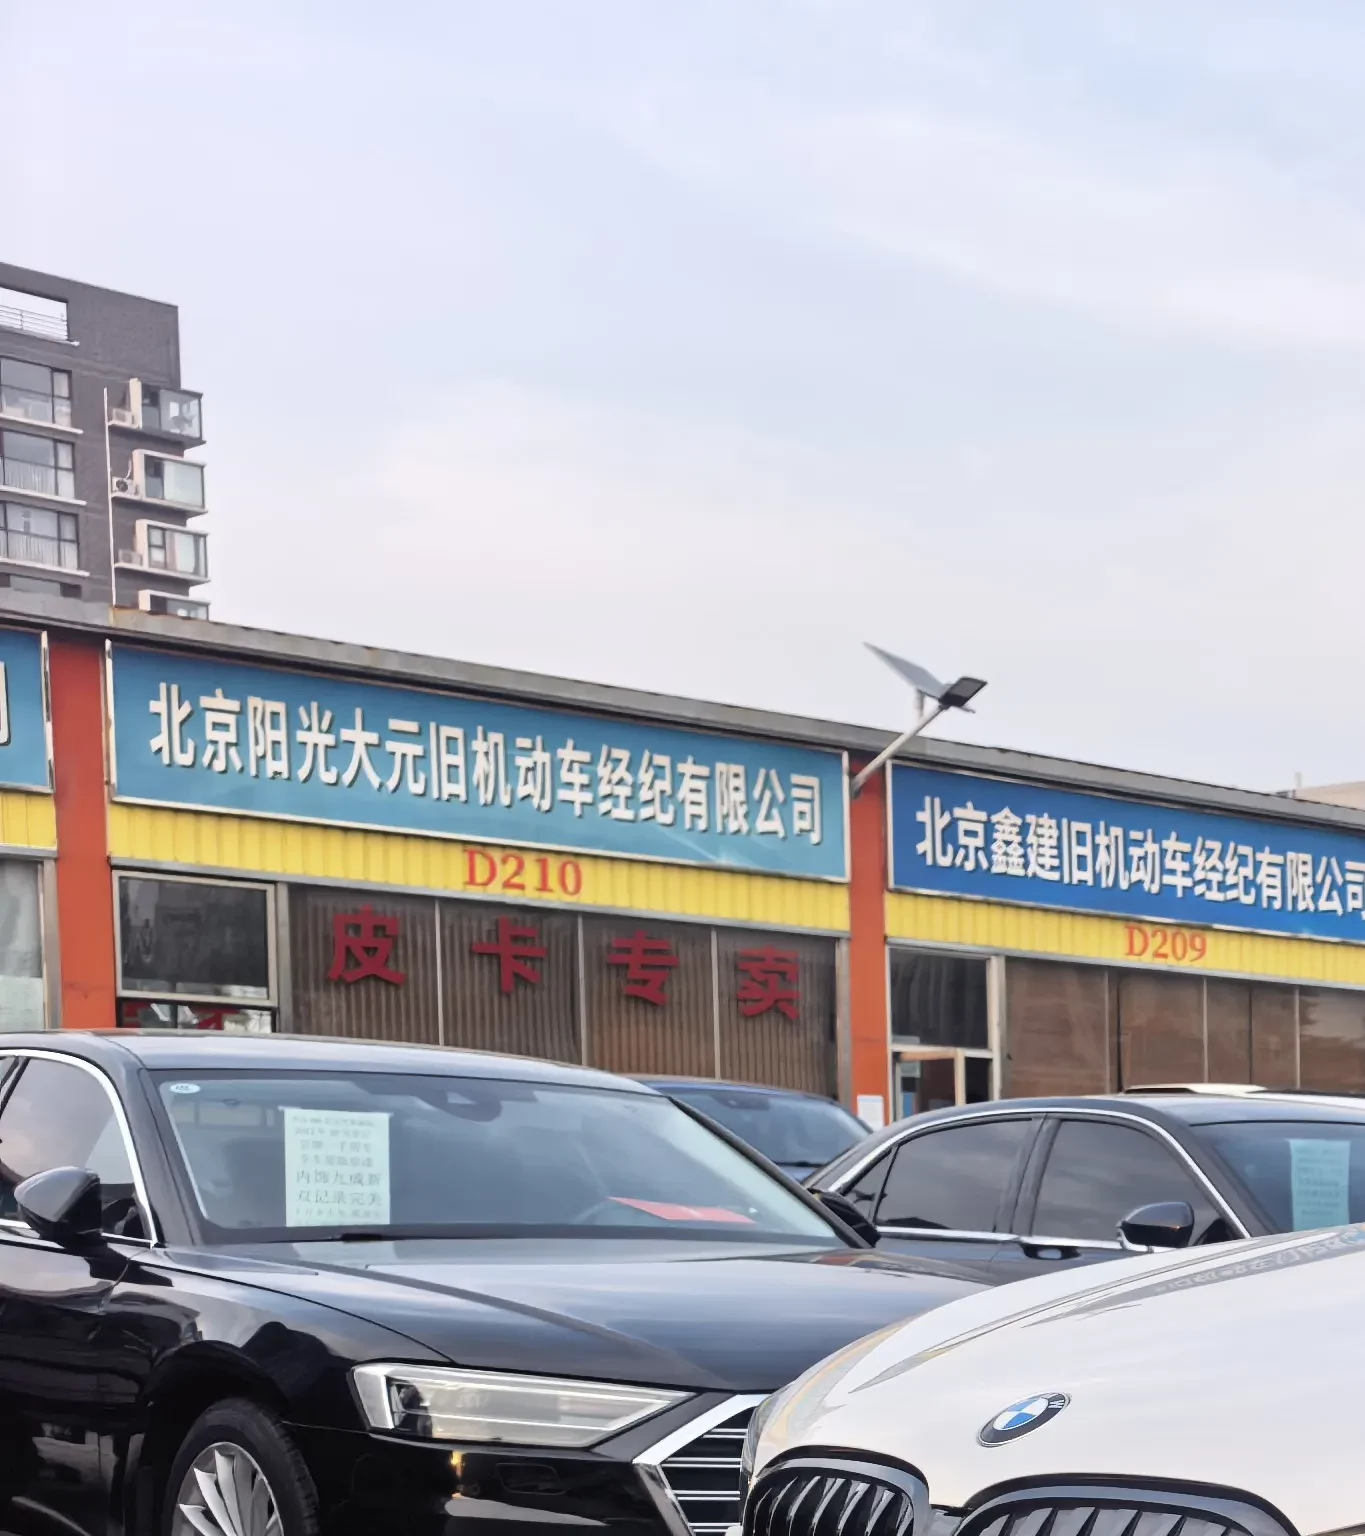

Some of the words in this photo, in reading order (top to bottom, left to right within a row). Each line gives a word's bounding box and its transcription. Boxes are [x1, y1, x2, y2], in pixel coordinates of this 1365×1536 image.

[148, 682, 823, 846] 北京阳光大元旧机动车经纪有限公司
[462, 847, 584, 897] D210
[326, 905, 802, 1022] 皮卡专卖
[1124, 923, 1208, 963] D209
